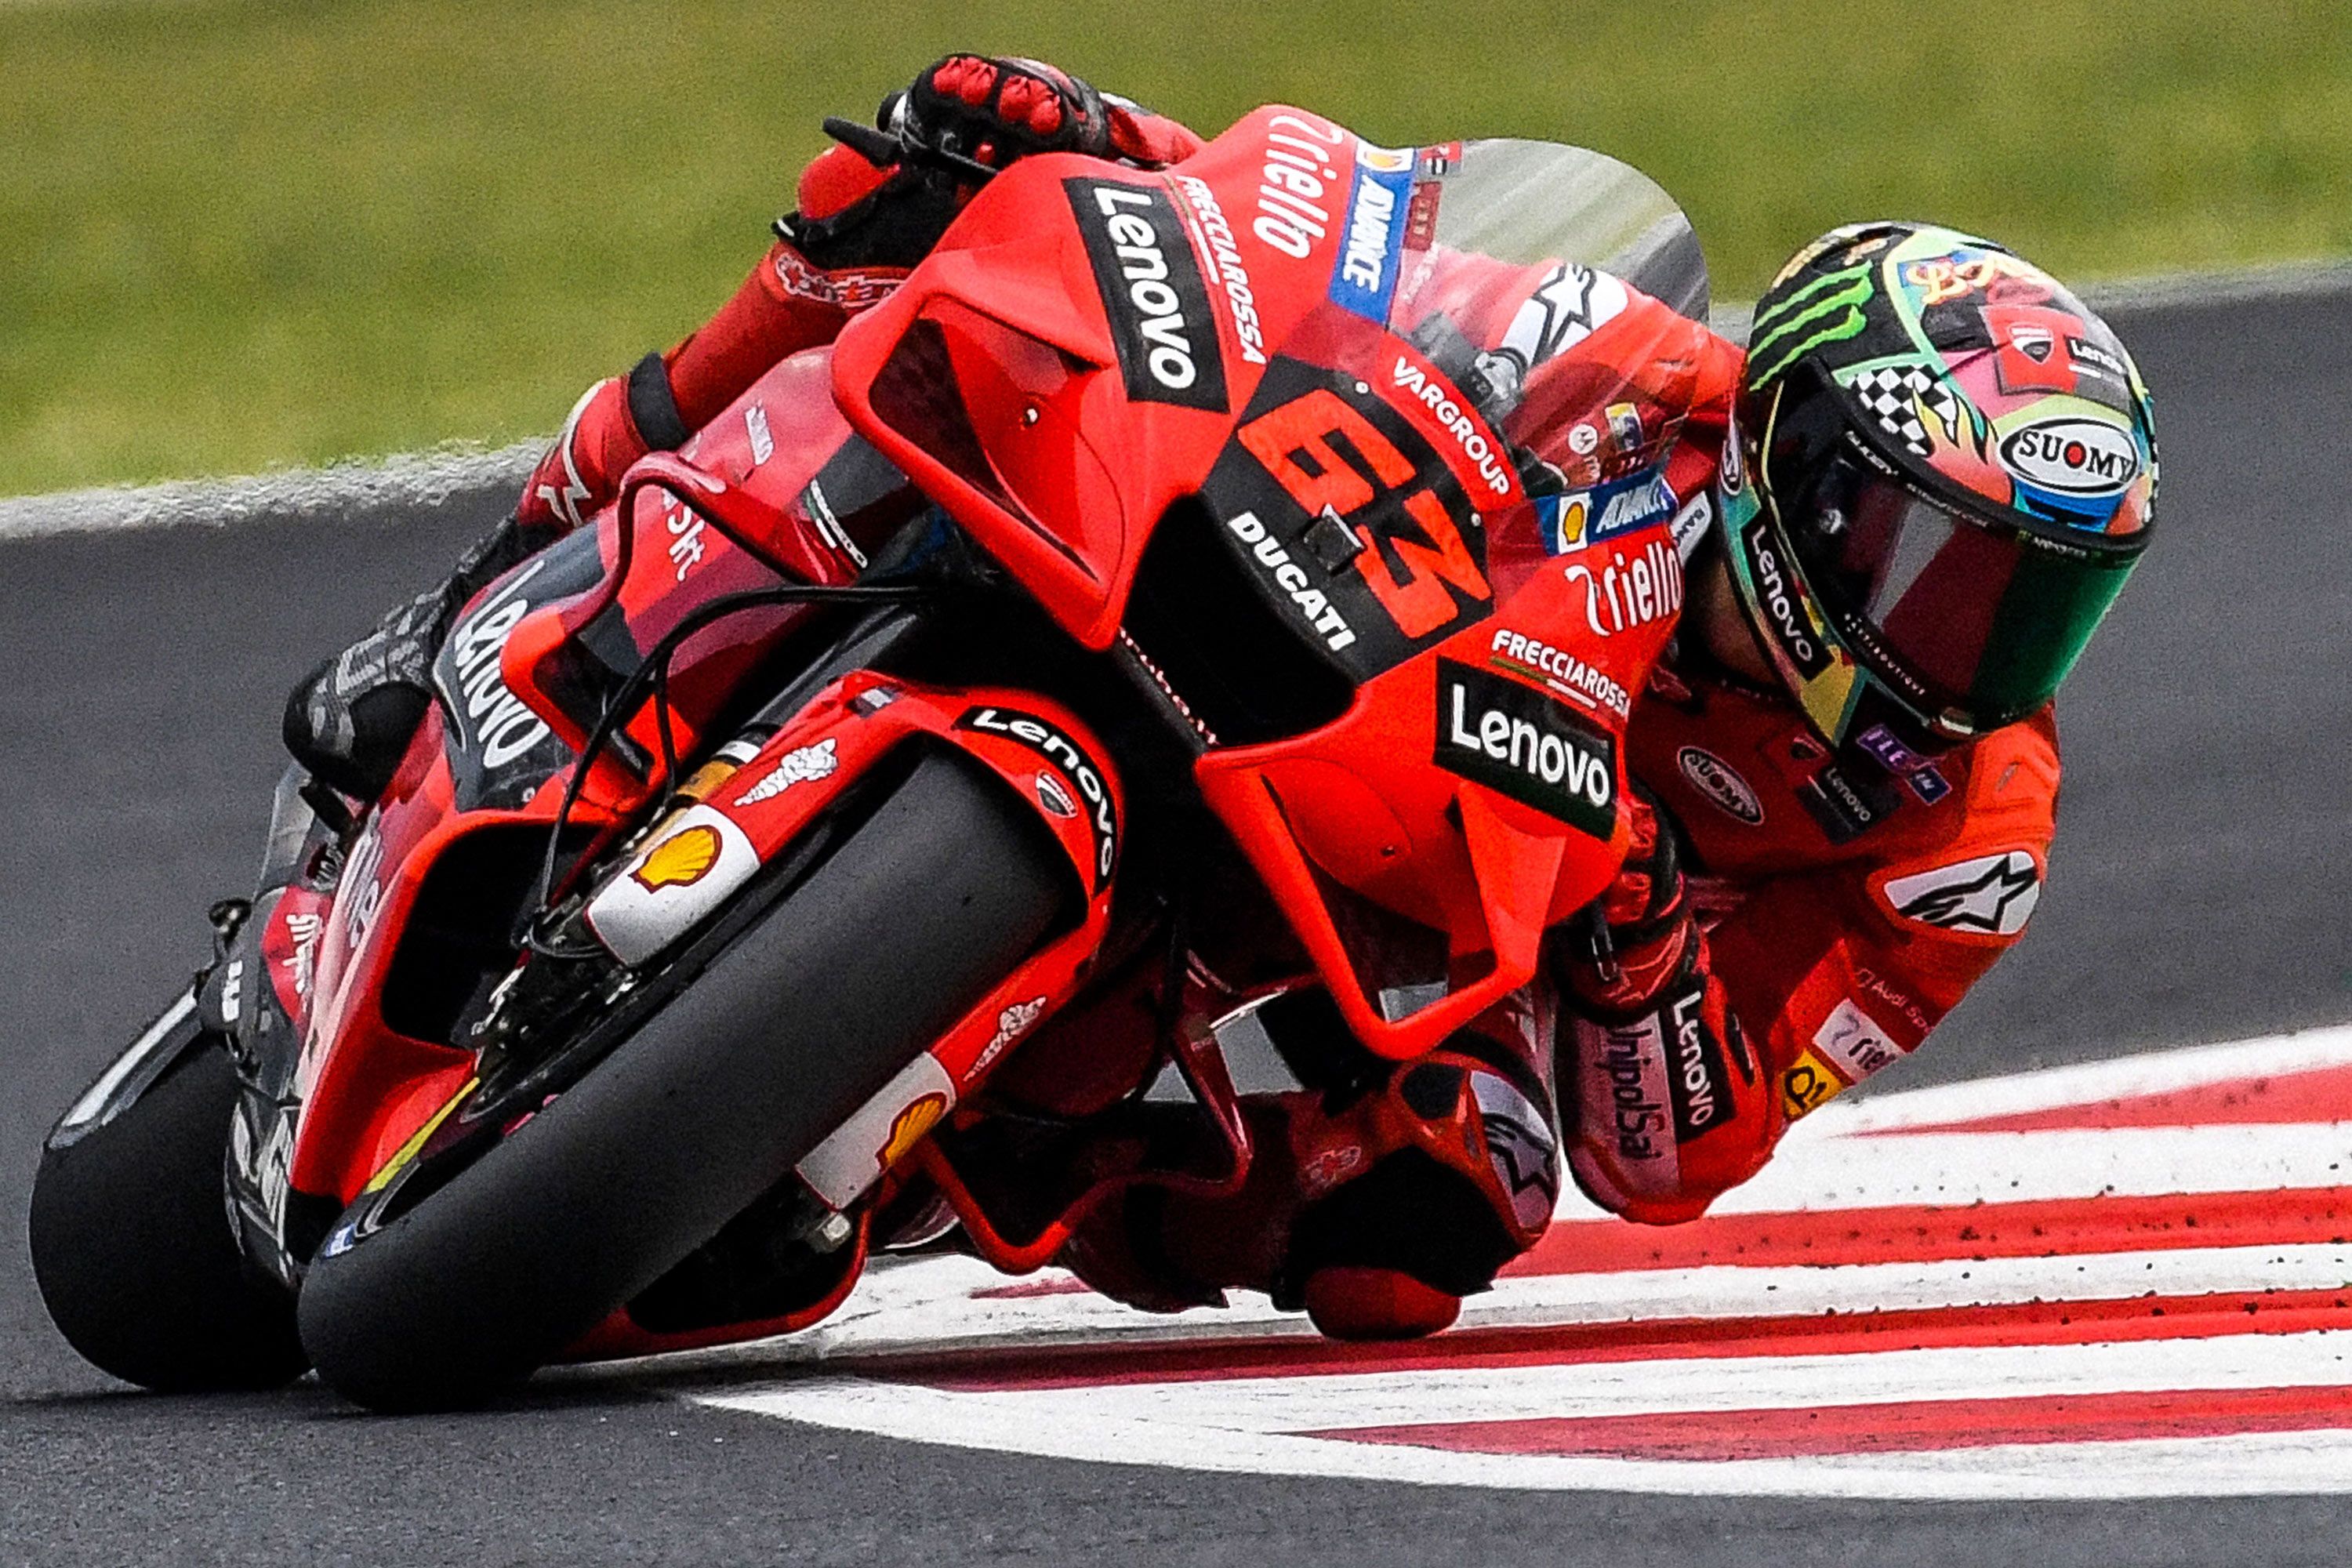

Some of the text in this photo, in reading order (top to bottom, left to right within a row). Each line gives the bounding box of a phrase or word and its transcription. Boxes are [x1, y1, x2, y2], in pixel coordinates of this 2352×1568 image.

[1093, 186, 1196, 390] Lenovo
[1176, 175, 1267, 365] FRECCIAROSSA
[1342, 173, 1396, 294] ADVANCE
[1393, 356, 1510, 495] VARGROUP
[2017, 430, 2135, 482] SUOMY
[1227, 510, 1357, 652] DUCATI
[1237, 388, 1491, 639] 63
[1751, 524, 1813, 662] Lenovo
[972, 709, 1113, 877] Lenovo
[1450, 683, 1610, 808] Lenovo
[1686, 750, 1759, 819] SUOMY
[1825, 768, 1872, 823] Lenovo
[1671, 990, 1715, 1127] Lenovo
